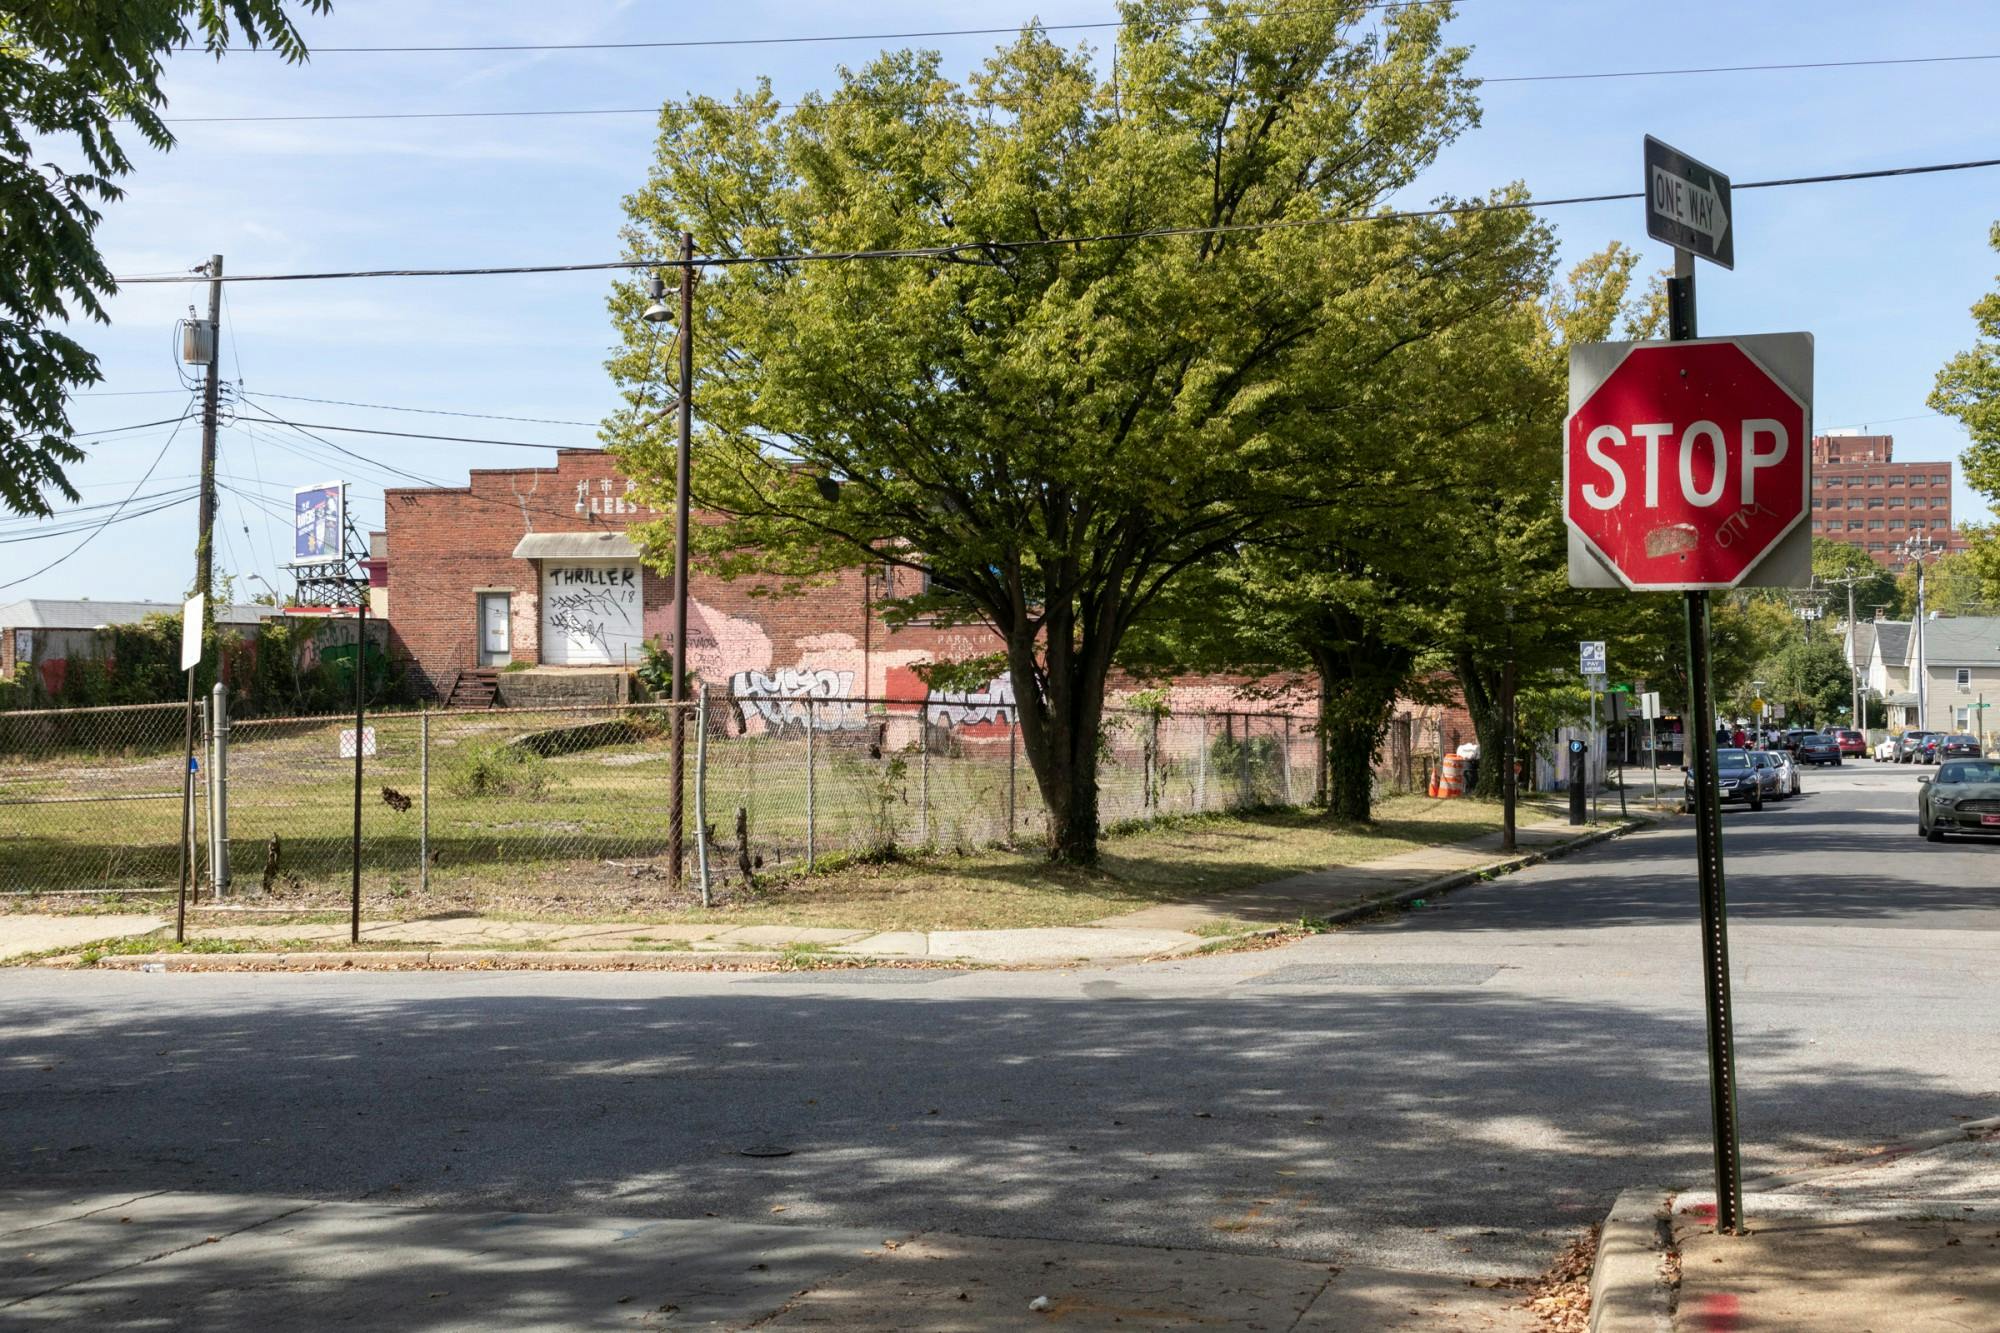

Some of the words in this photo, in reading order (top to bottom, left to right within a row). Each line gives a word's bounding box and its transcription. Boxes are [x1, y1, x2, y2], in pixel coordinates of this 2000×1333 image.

[1656, 173, 1684, 218] ONE
[1688, 187, 1714, 233] WAY
[1581, 418, 1790, 511] STOP
[549, 568, 635, 589] THRILLER
[620, 590, 636, 604] 18
